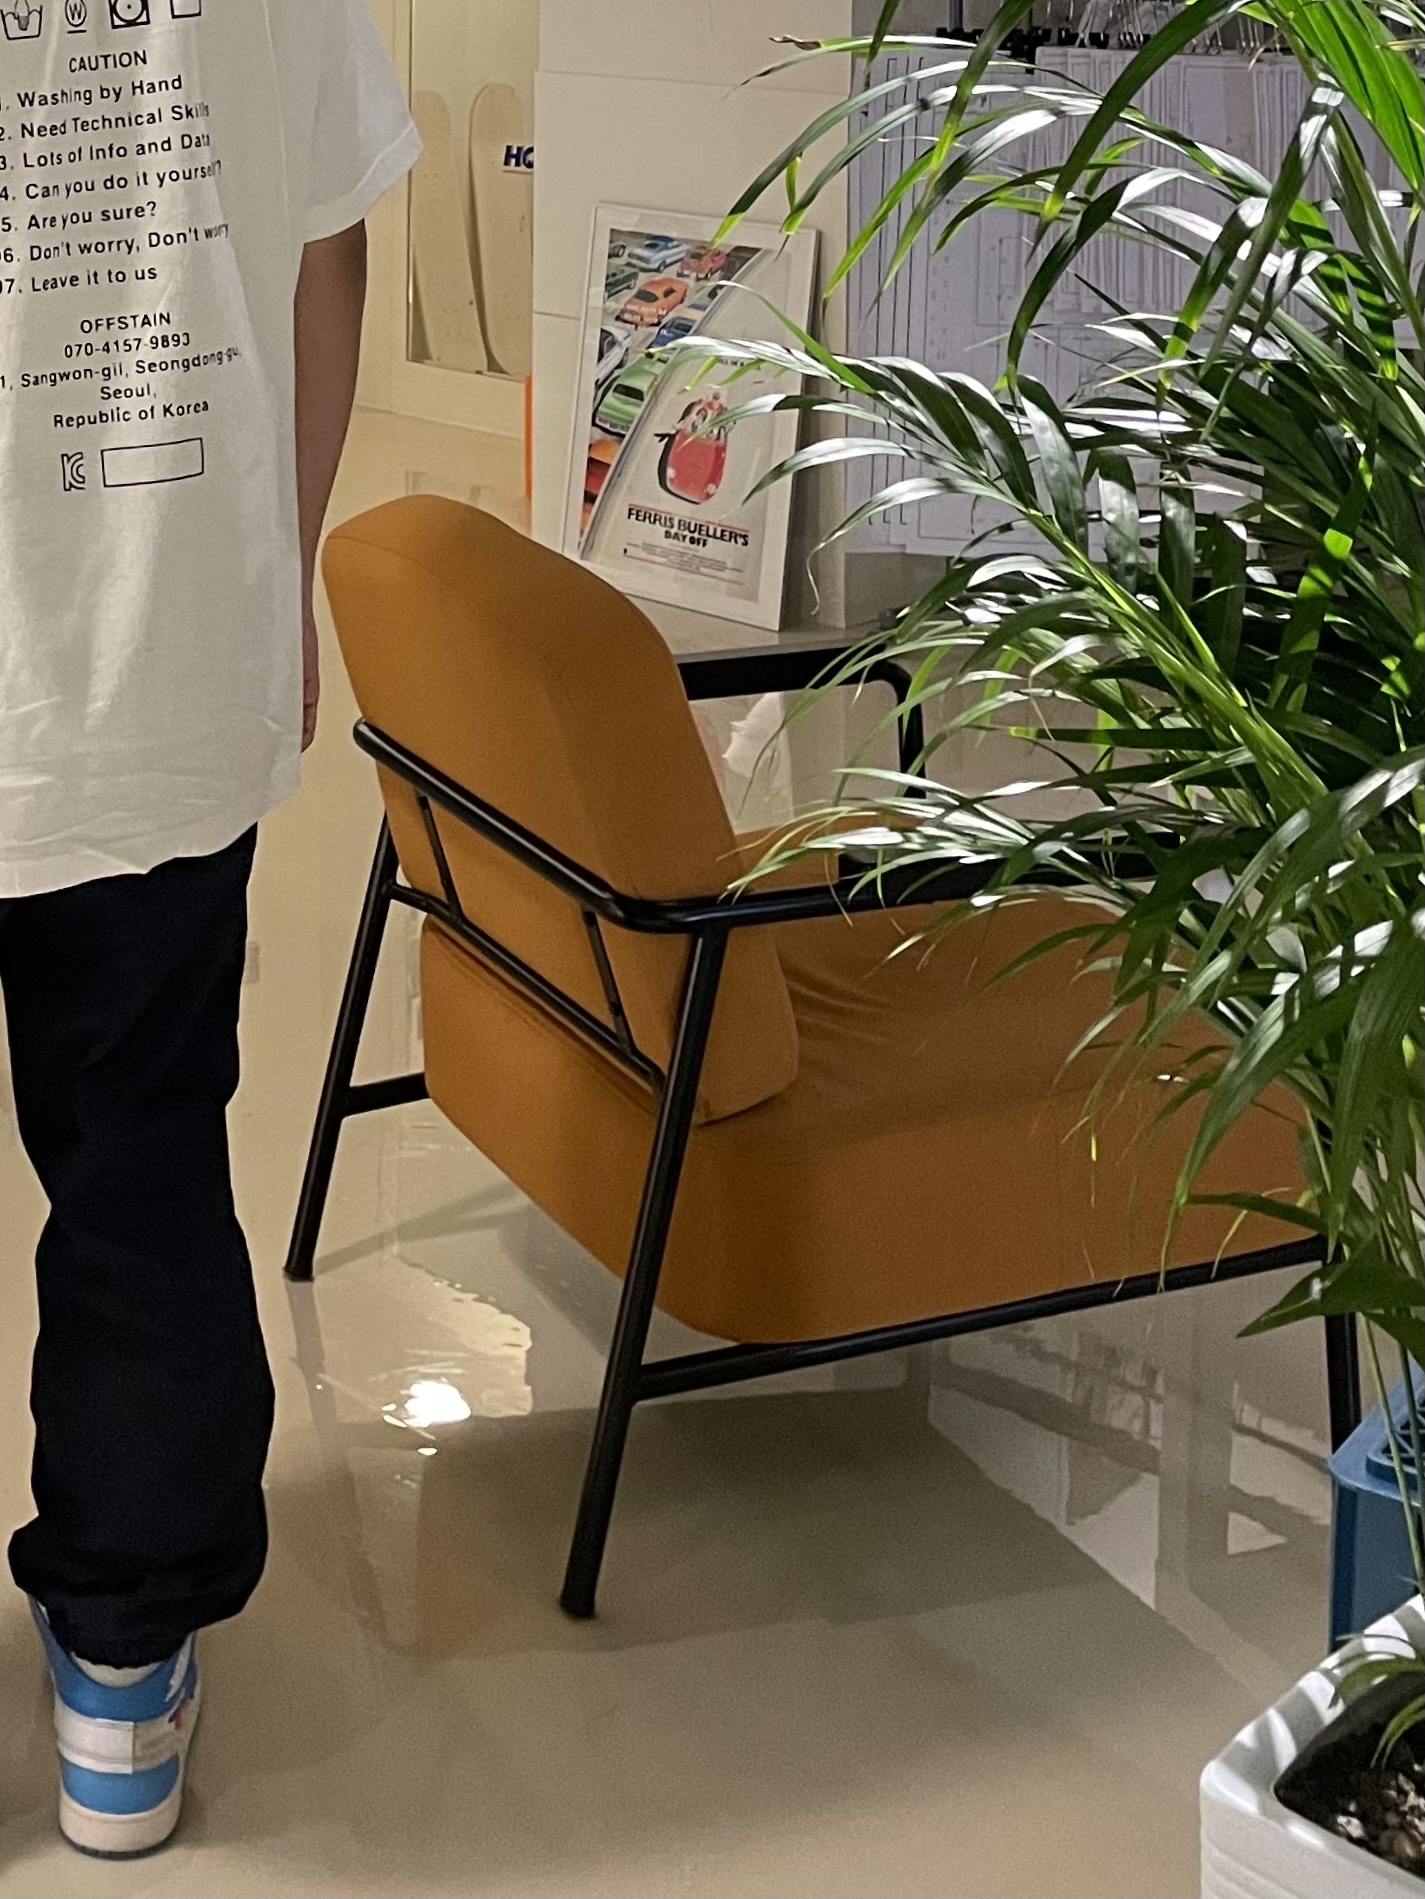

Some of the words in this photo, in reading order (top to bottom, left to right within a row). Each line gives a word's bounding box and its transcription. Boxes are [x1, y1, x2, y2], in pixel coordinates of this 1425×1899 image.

[69, 50, 148, 73] CAUTION
[17, 88, 92, 108] Washing
[100, 84, 122, 102] by
[131, 75, 182, 96] Hand
[21, 120, 66, 139] Need
[72, 108, 162, 133] Technical
[23, 150, 63, 168] Lots
[68, 146, 83, 164] of
[90, 143, 127, 161] Info
[135, 136, 172, 156] and
[26, 183, 60, 200] Can
[65, 178, 95, 199] you
[103, 174, 128, 190] do
[136, 171, 148, 187] it
[28, 214, 56, 231] Are
[61, 209, 92, 230] you
[101, 201, 157, 222] sure?
[30, 242, 71, 261] Don't
[78, 238, 140, 255] worry,
[148, 227, 199, 248] Don't
[31, 273, 79, 292] Leave
[87, 269, 99, 285] it
[107, 268, 126, 283] to
[135, 267, 157, 280] us
[80, 312, 171, 334] OFFSTAIN
[64, 333, 190, 358] 070-4157-9893
[21, 362, 129, 388] Sangwon-gil,
[100, 383, 157, 401] Seoul,
[54, 406, 131, 428] Republic
[138, 406, 155, 420] of
[162, 400, 209, 418] Korea
[627, 507, 675, 529] FERRIS
[678, 519, 749, 546] BUELLER'S
[664, 531, 688, 543] DAY
[689, 535, 708, 548] OFF
